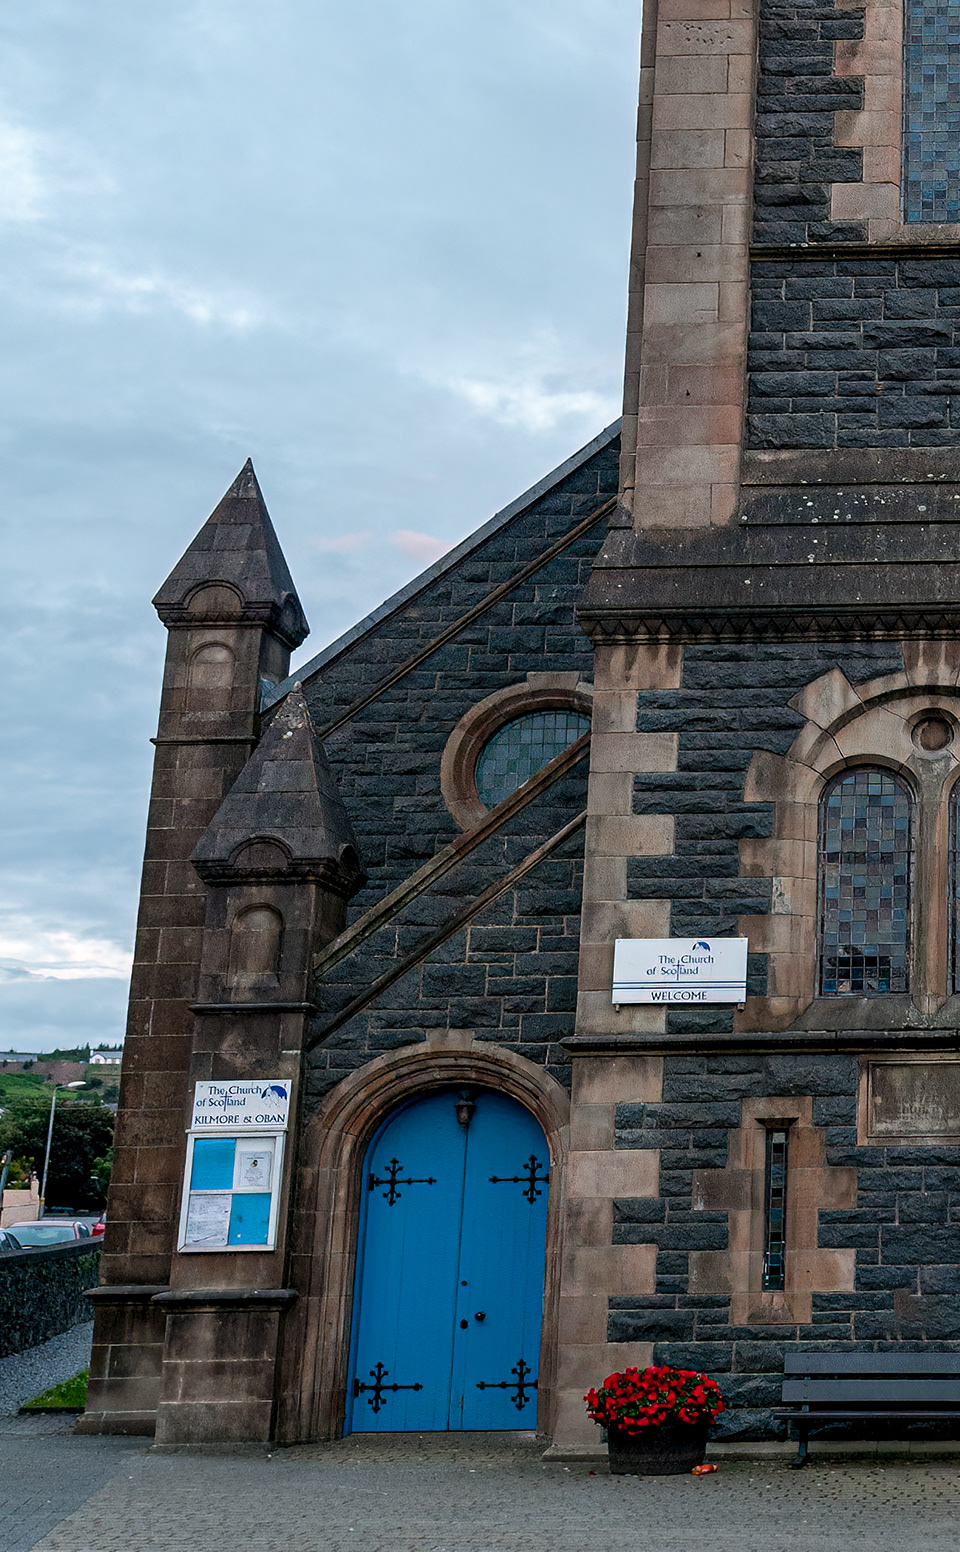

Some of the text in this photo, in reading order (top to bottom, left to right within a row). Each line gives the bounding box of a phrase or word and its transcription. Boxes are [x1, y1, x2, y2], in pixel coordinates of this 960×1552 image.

[658, 955, 714, 964] The Church
[646, 964, 699, 978] of Scotland
[651, 991, 708, 1001] WELCOME
[208, 1086, 262, 1095] The Church
[196, 1095, 246, 1110] of Scotland
[194, 1114, 286, 1124] KILMORE & OBAN
